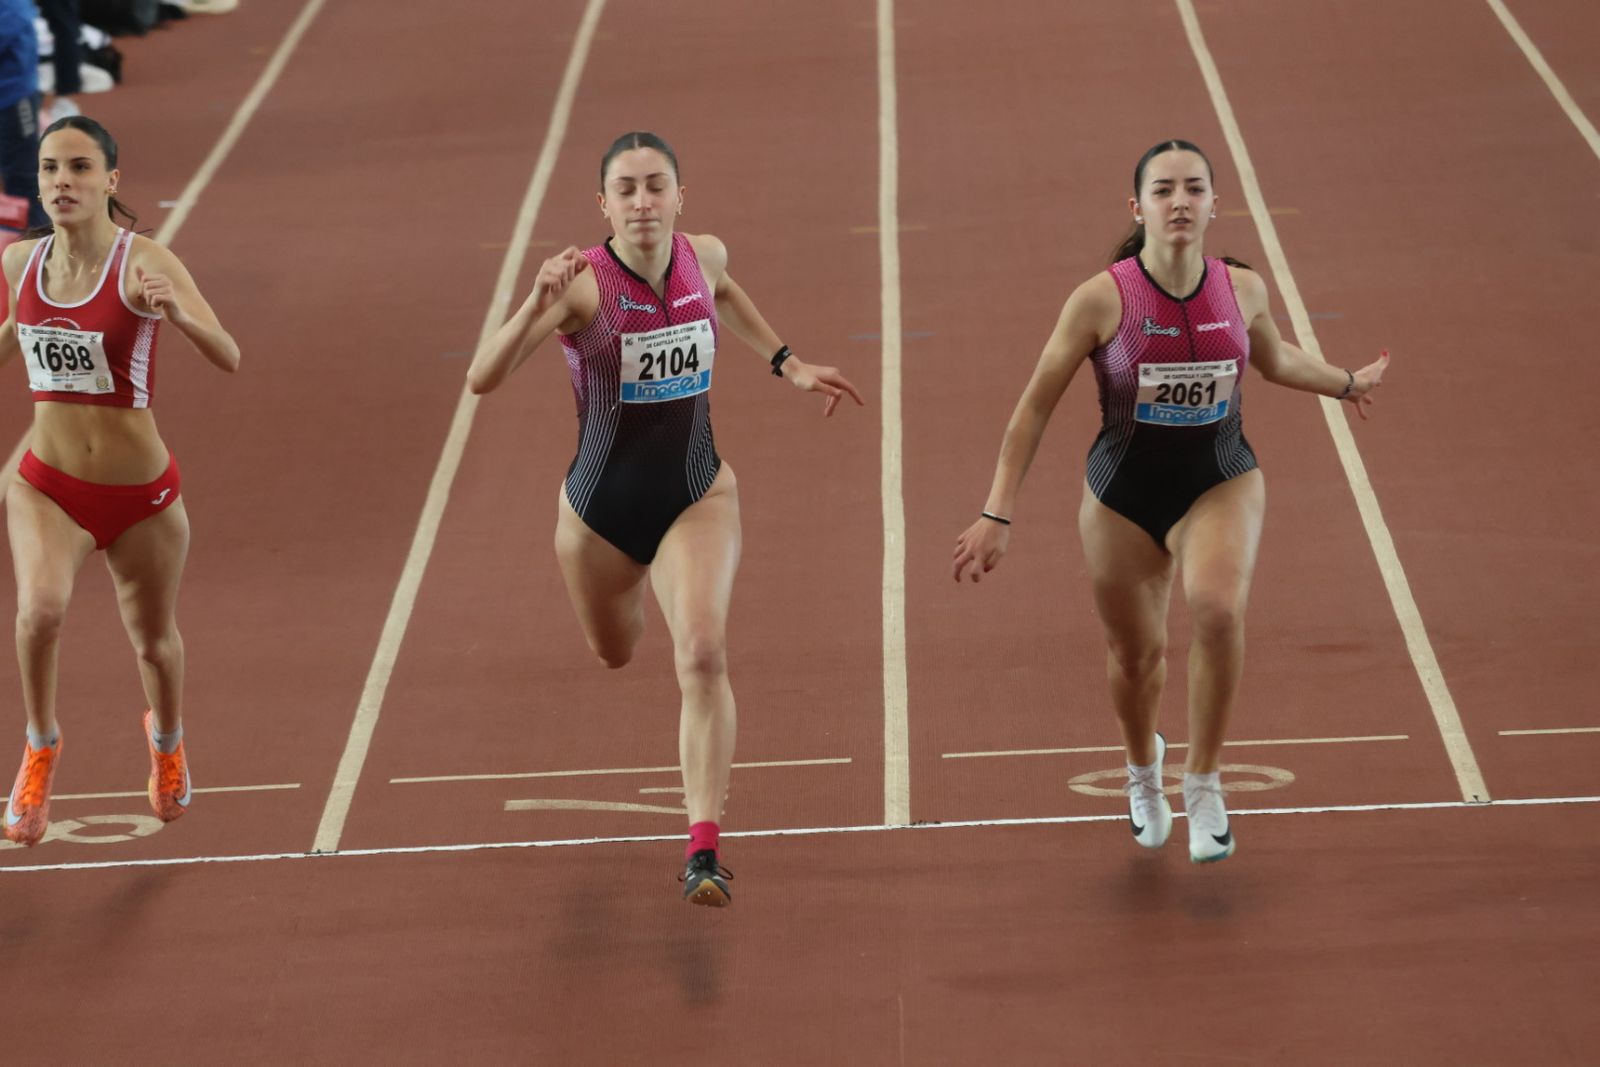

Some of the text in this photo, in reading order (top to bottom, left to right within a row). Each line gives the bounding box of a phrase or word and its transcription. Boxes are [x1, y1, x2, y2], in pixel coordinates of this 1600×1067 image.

[32, 341, 95, 372] 1698
[638, 342, 699, 381] 2104
[1154, 380, 1217, 407] 2061
